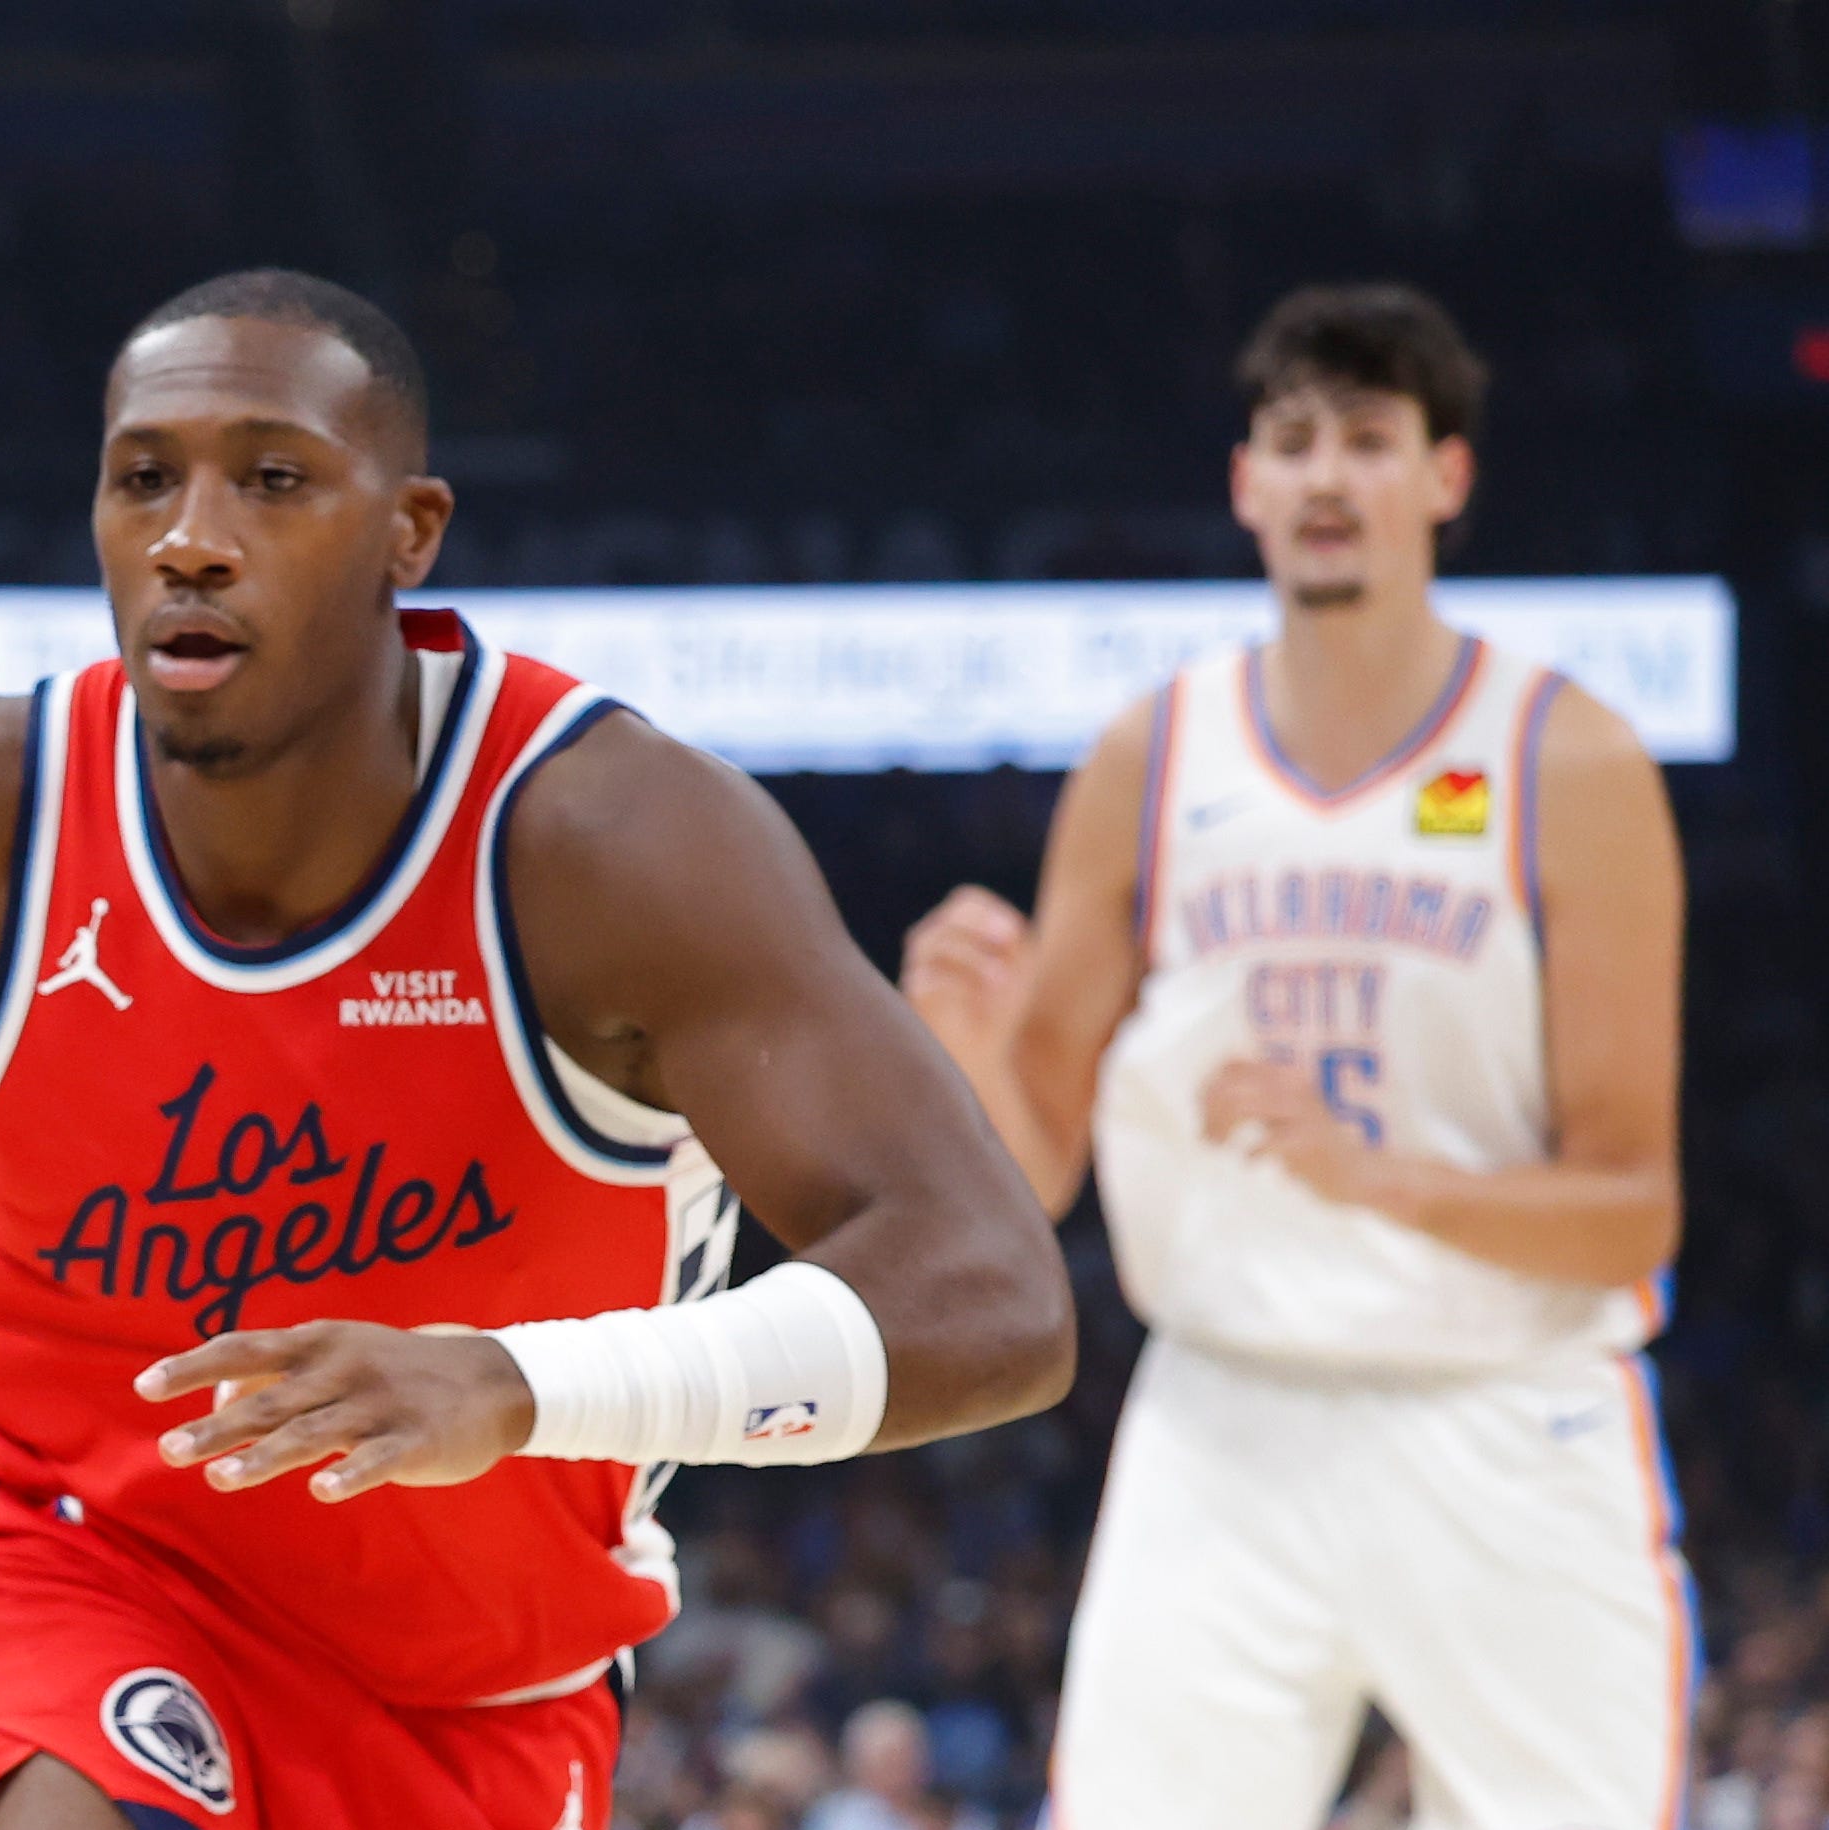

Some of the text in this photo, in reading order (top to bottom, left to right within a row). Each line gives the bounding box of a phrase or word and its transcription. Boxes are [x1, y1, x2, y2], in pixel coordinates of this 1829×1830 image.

[339, 997, 487, 1027] RWANDA
[369, 969, 458, 998] VISIT
[142, 1062, 351, 1206] Los
[38, 1142, 517, 1341] Angeles
